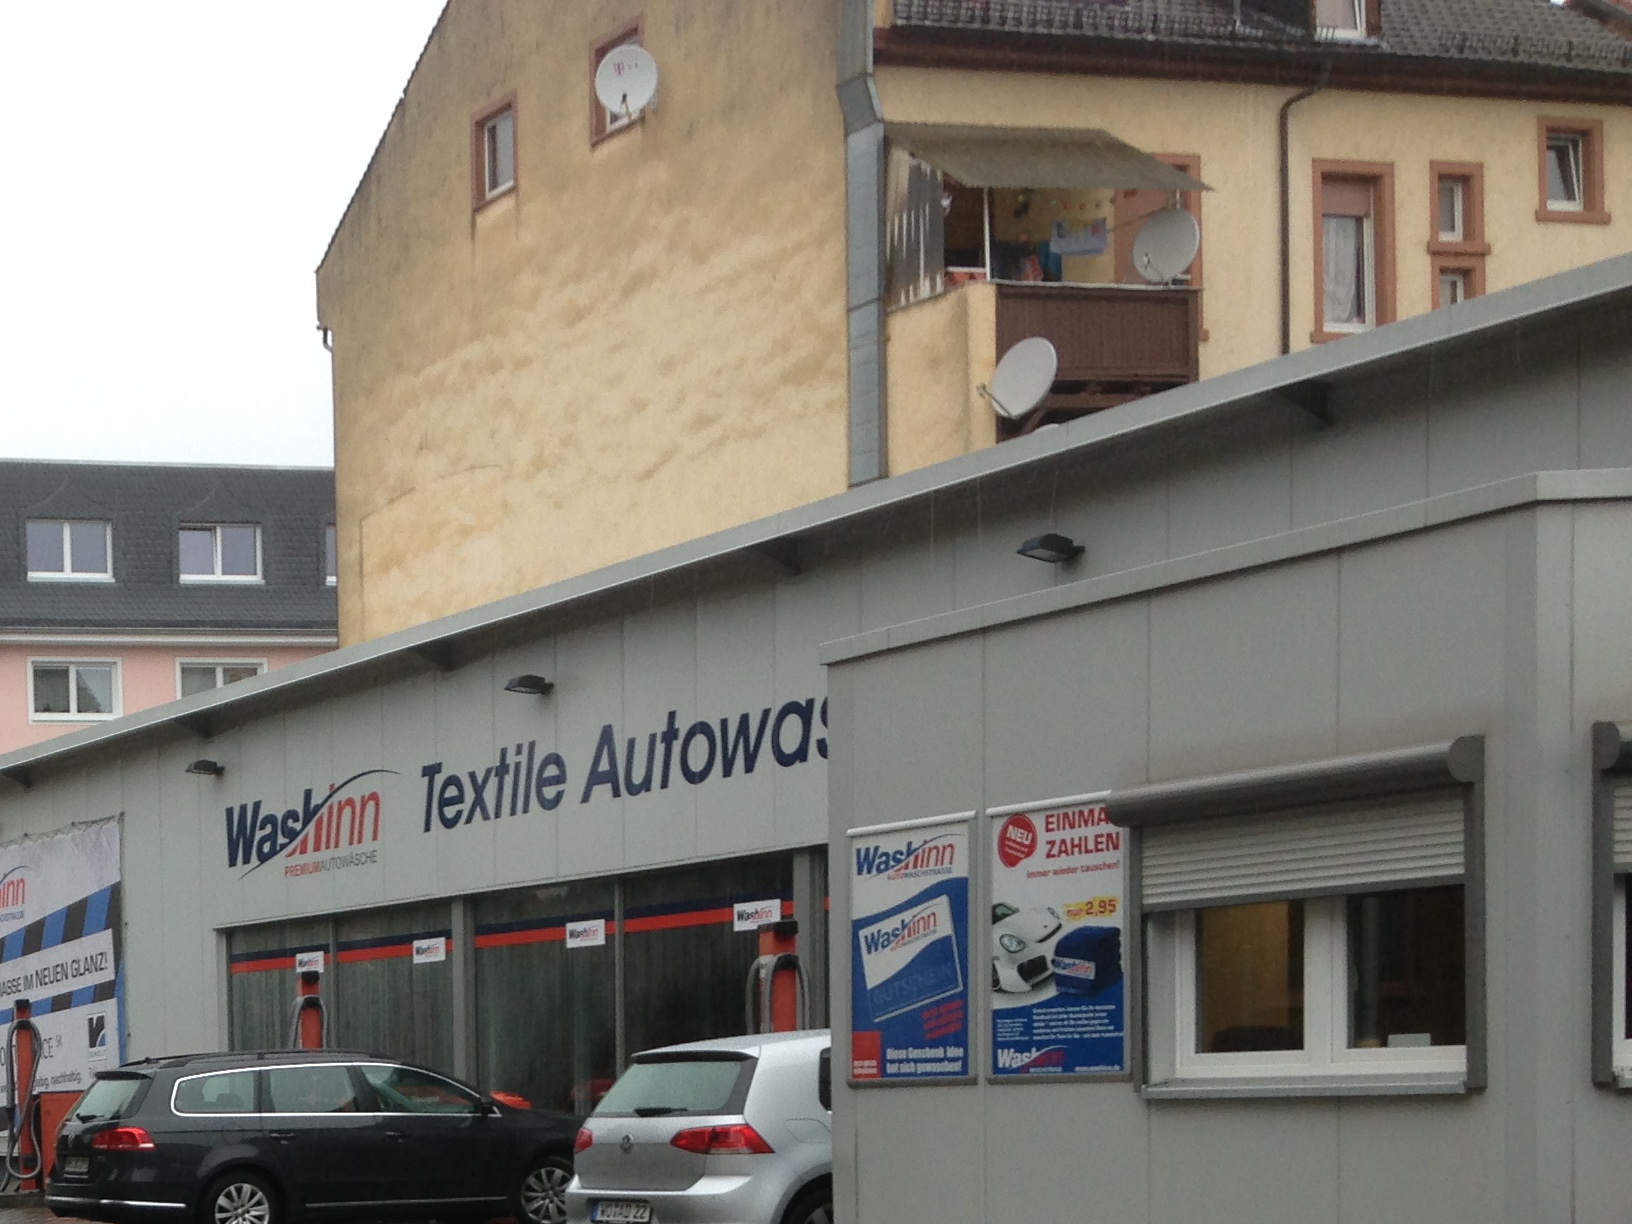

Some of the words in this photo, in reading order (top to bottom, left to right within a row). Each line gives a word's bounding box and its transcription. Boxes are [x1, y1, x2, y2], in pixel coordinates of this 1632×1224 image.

[421, 740, 567, 833] Textile
[225, 783, 381, 868] Washinn
[1044, 806, 1111, 833] EINMA
[1045, 832, 1120, 859] ZAHLEN
[1085, 898, 1118, 917] 2,95
[35, 963, 69, 988] NEUEN
[70, 951, 108, 978] GLANZ!
